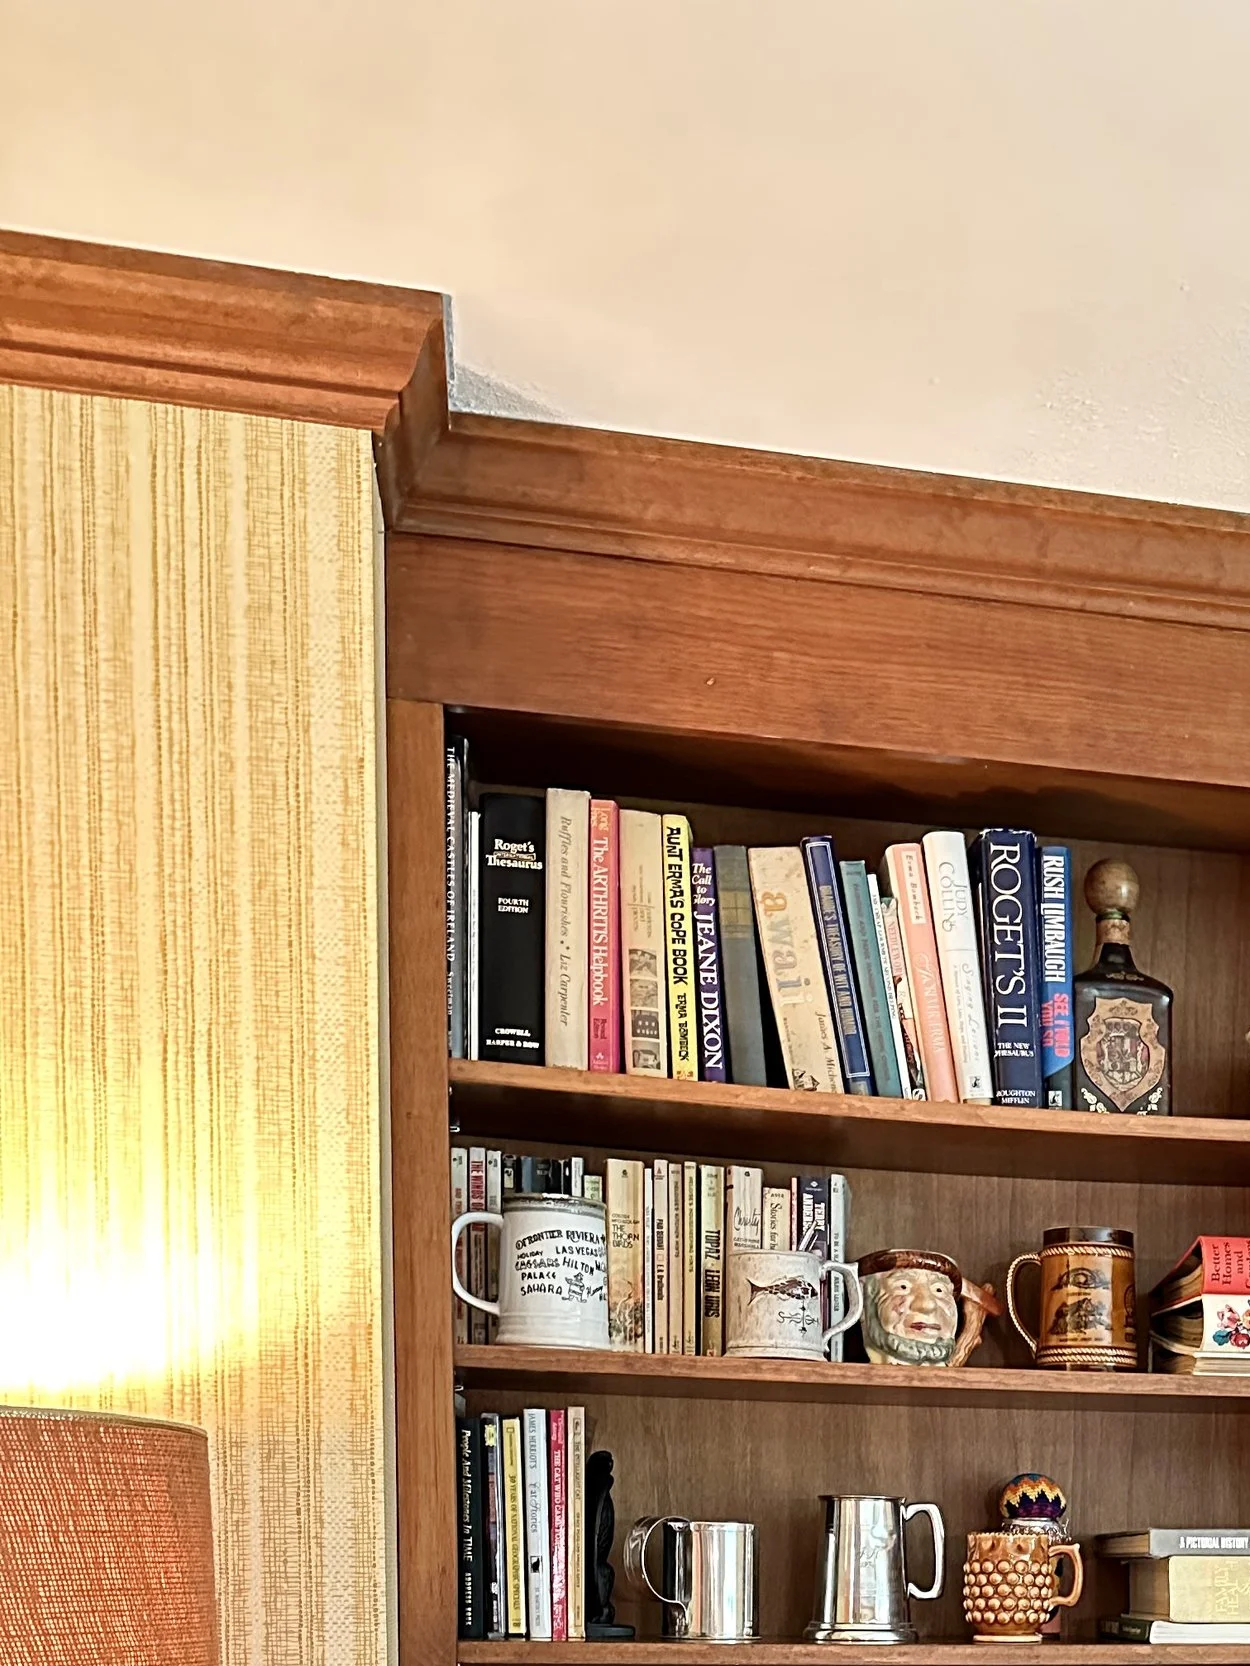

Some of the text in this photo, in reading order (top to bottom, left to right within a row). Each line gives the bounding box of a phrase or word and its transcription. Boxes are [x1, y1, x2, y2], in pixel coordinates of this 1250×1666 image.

[486, 854, 543, 870] Thesaurus
[494, 839, 535, 854] Roget's
[593, 839, 609, 863] The
[666, 827, 683, 862] AUNT
[560, 816, 572, 937] Ruffles and Flourishes
[692, 863, 711, 874] The
[692, 874, 711, 885] Call
[1043, 855, 1065, 900] RUSH
[498, 897, 529, 906] FOURTH
[592, 864, 609, 943] ARTHRITIS
[668, 864, 684, 909] ERMA'S
[697, 884, 707, 894] to
[939, 861, 954, 932] COLLINS
[954, 883, 969, 921] JUDY
[498, 906, 529, 914] EDITION
[990, 844, 1028, 1028] ROGET'S II
[1041, 903, 1066, 983] LIMBAUGH
[590, 944, 608, 1006] Helpbook
[672, 948, 688, 985] BOOK
[560, 954, 572, 1027] Liz Carpenter
[694, 910, 724, 1070] JEANE DIXON
[522, 1230, 600, 1247] FRONTIER RIVIERA
[612, 1224, 626, 1232] THE
[612, 1233, 640, 1241] THORN
[734, 1206, 761, 1236] Christy
[556, 1246, 598, 1258] LAS VEGAS
[562, 1256, 594, 1276] HILTON
[1211, 1244, 1220, 1283] Better
[1222, 1242, 1232, 1285] Homes
[520, 1283, 562, 1296] SAHARA
[704, 1230, 720, 1318] TOPAZ LEON URIS
